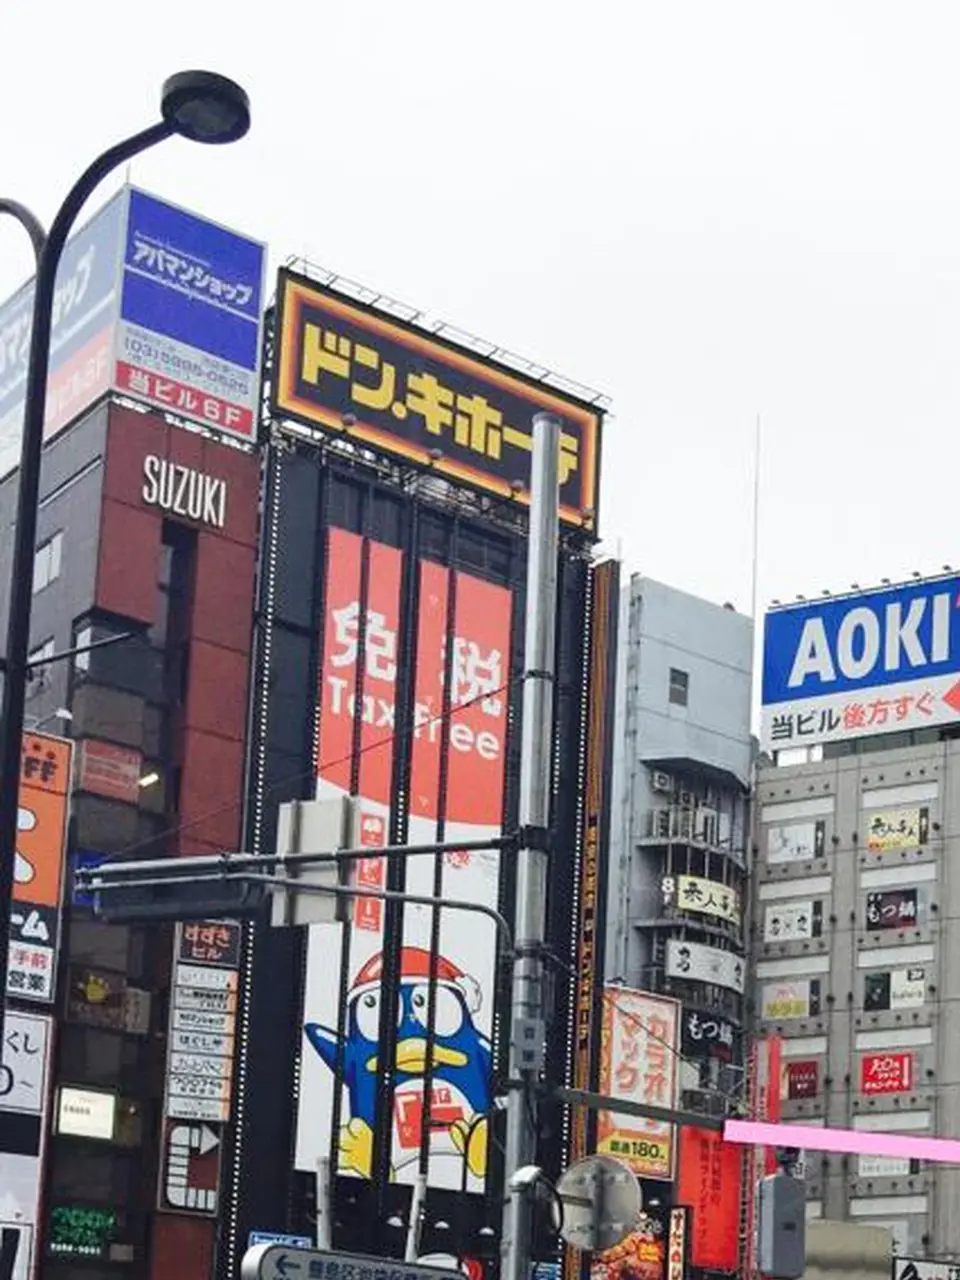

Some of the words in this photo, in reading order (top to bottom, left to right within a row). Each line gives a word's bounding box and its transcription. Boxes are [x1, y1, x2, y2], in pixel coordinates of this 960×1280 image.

[132, 240, 253, 306] アパマンショップ
[142, 454, 227, 527] SUZUKI
[787, 592, 951, 688] AOKI
[327, 675, 395, 728] Tax
[411, 699, 500, 759] Free
[771, 692, 936, 741] 当ビル後方すぐ
